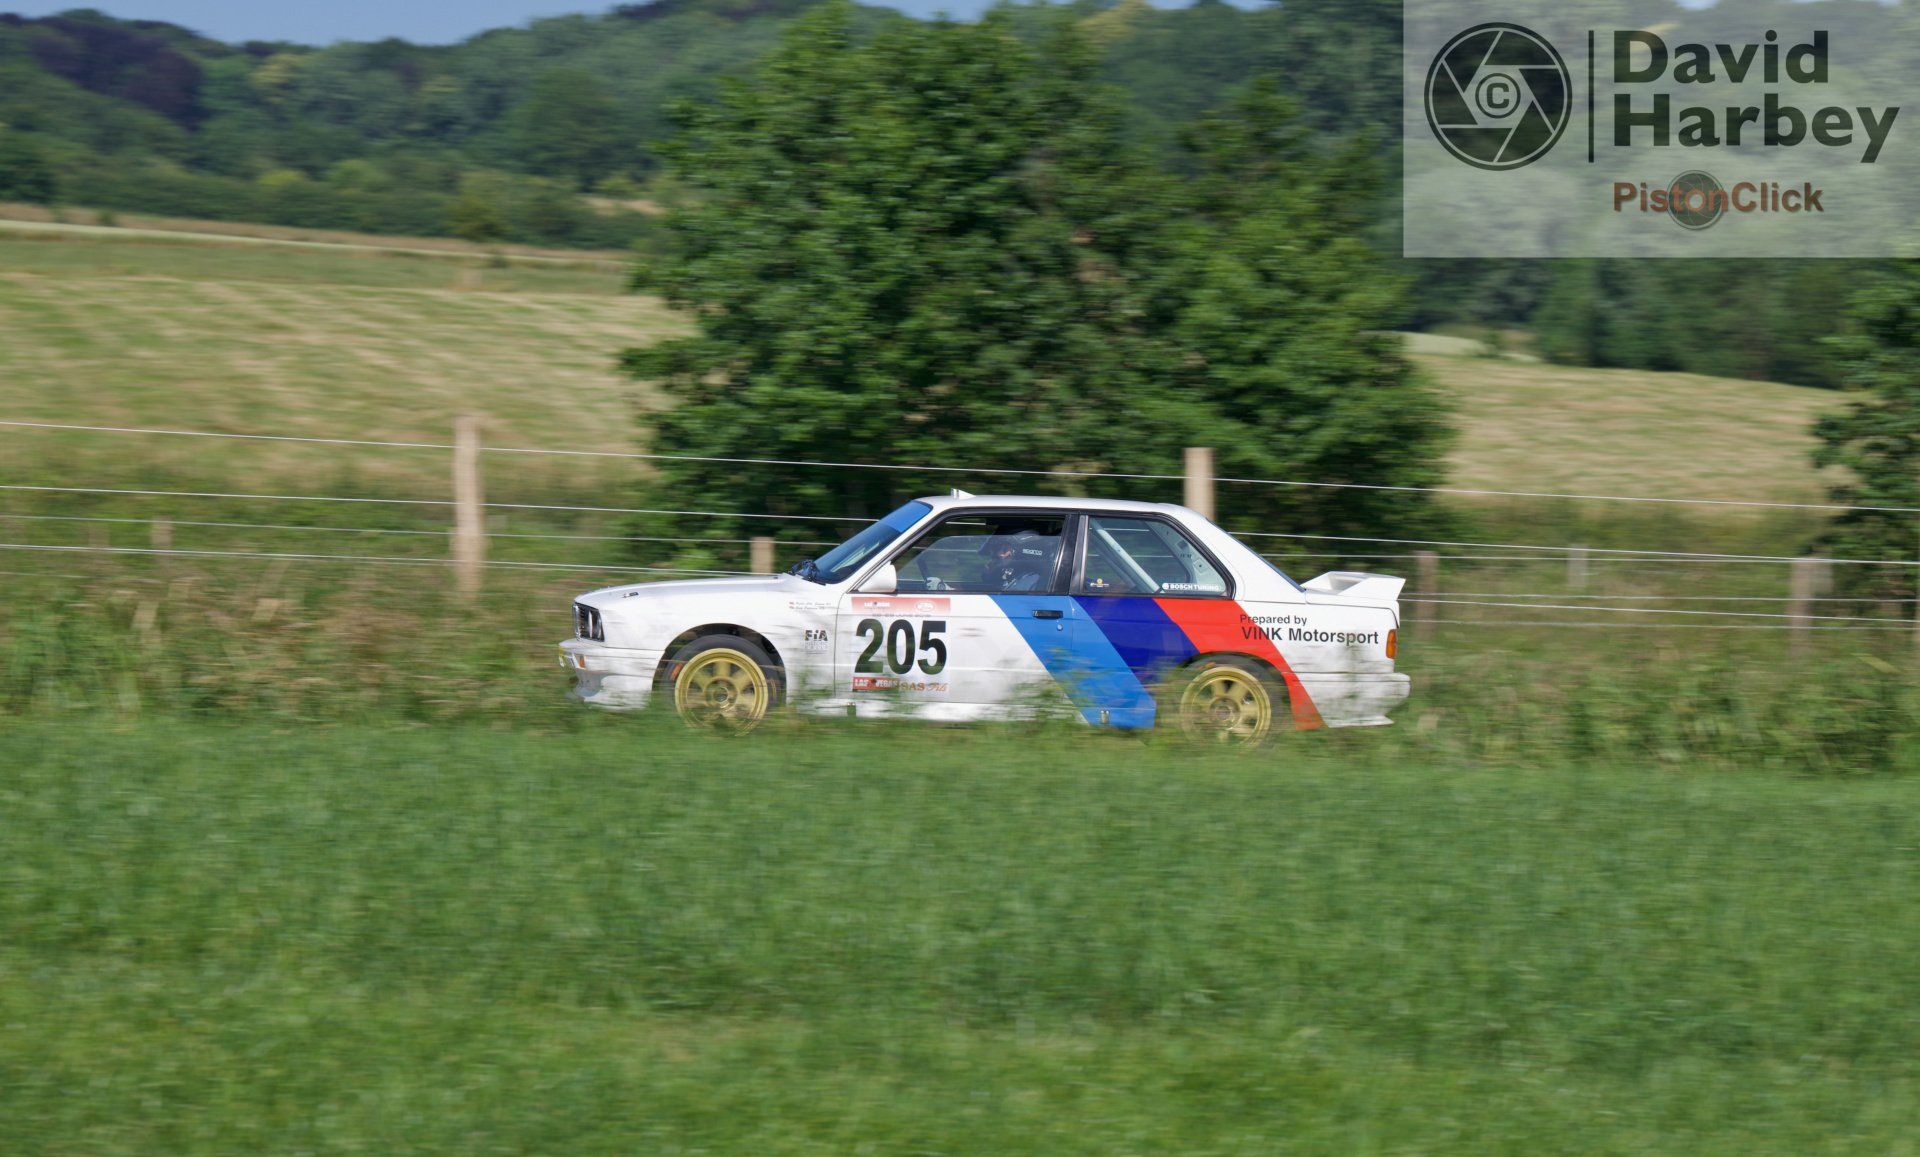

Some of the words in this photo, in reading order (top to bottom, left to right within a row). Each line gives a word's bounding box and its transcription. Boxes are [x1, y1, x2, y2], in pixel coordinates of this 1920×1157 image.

[1240, 614, 1291, 625] Prepared
[1294, 615, 1308, 626] by
[1241, 626, 1283, 641] VINK
[1289, 628, 1379, 646] Motorsport
[854, 618, 948, 675] 205
